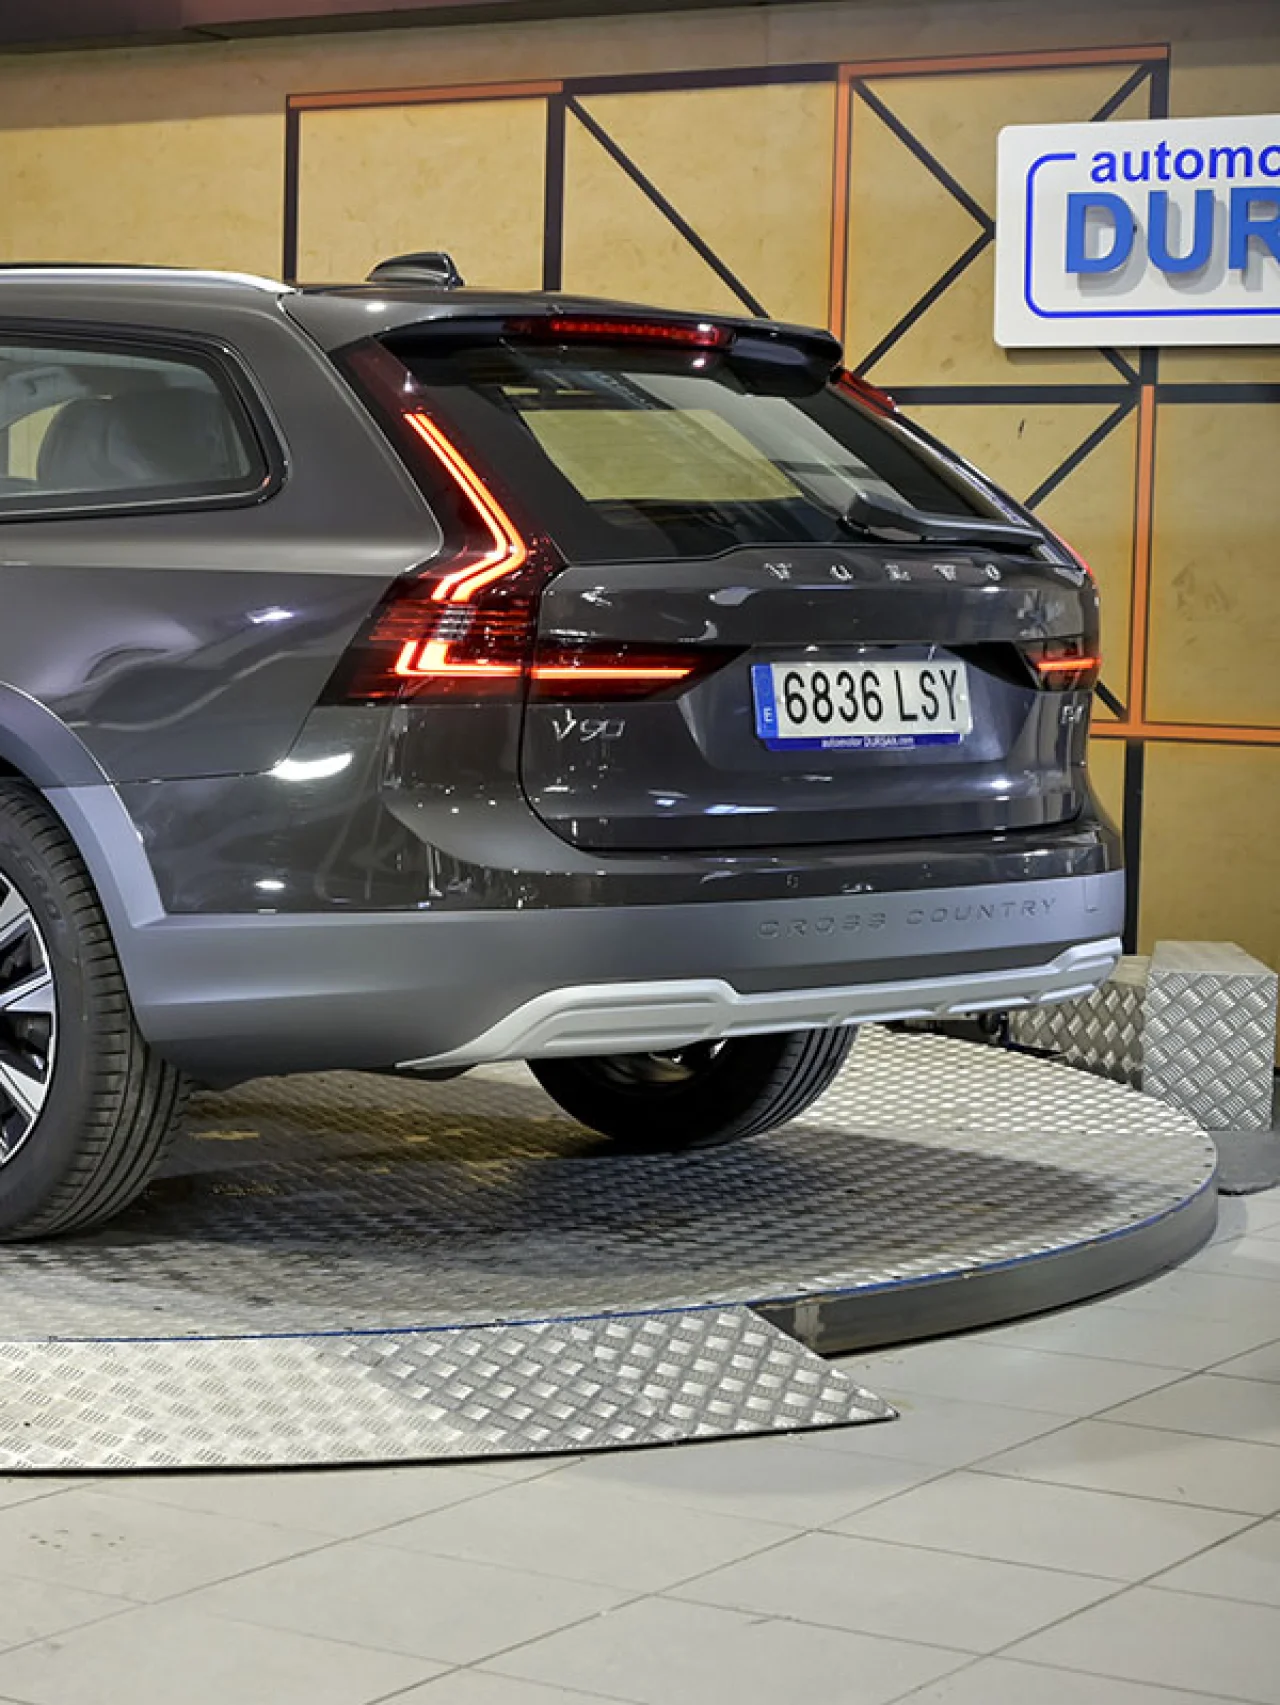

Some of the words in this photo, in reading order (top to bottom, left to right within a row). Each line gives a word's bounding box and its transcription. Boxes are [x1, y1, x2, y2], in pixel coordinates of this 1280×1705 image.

[764, 563, 1001, 581] VOLVO
[784, 671, 884, 724] 6836
[894, 669, 958, 722] LSY
[552, 708, 626, 741] V90
[763, 707, 773, 722] E
[757, 911, 886, 937] CROSS
[906, 897, 1057, 924] COUNTRY
